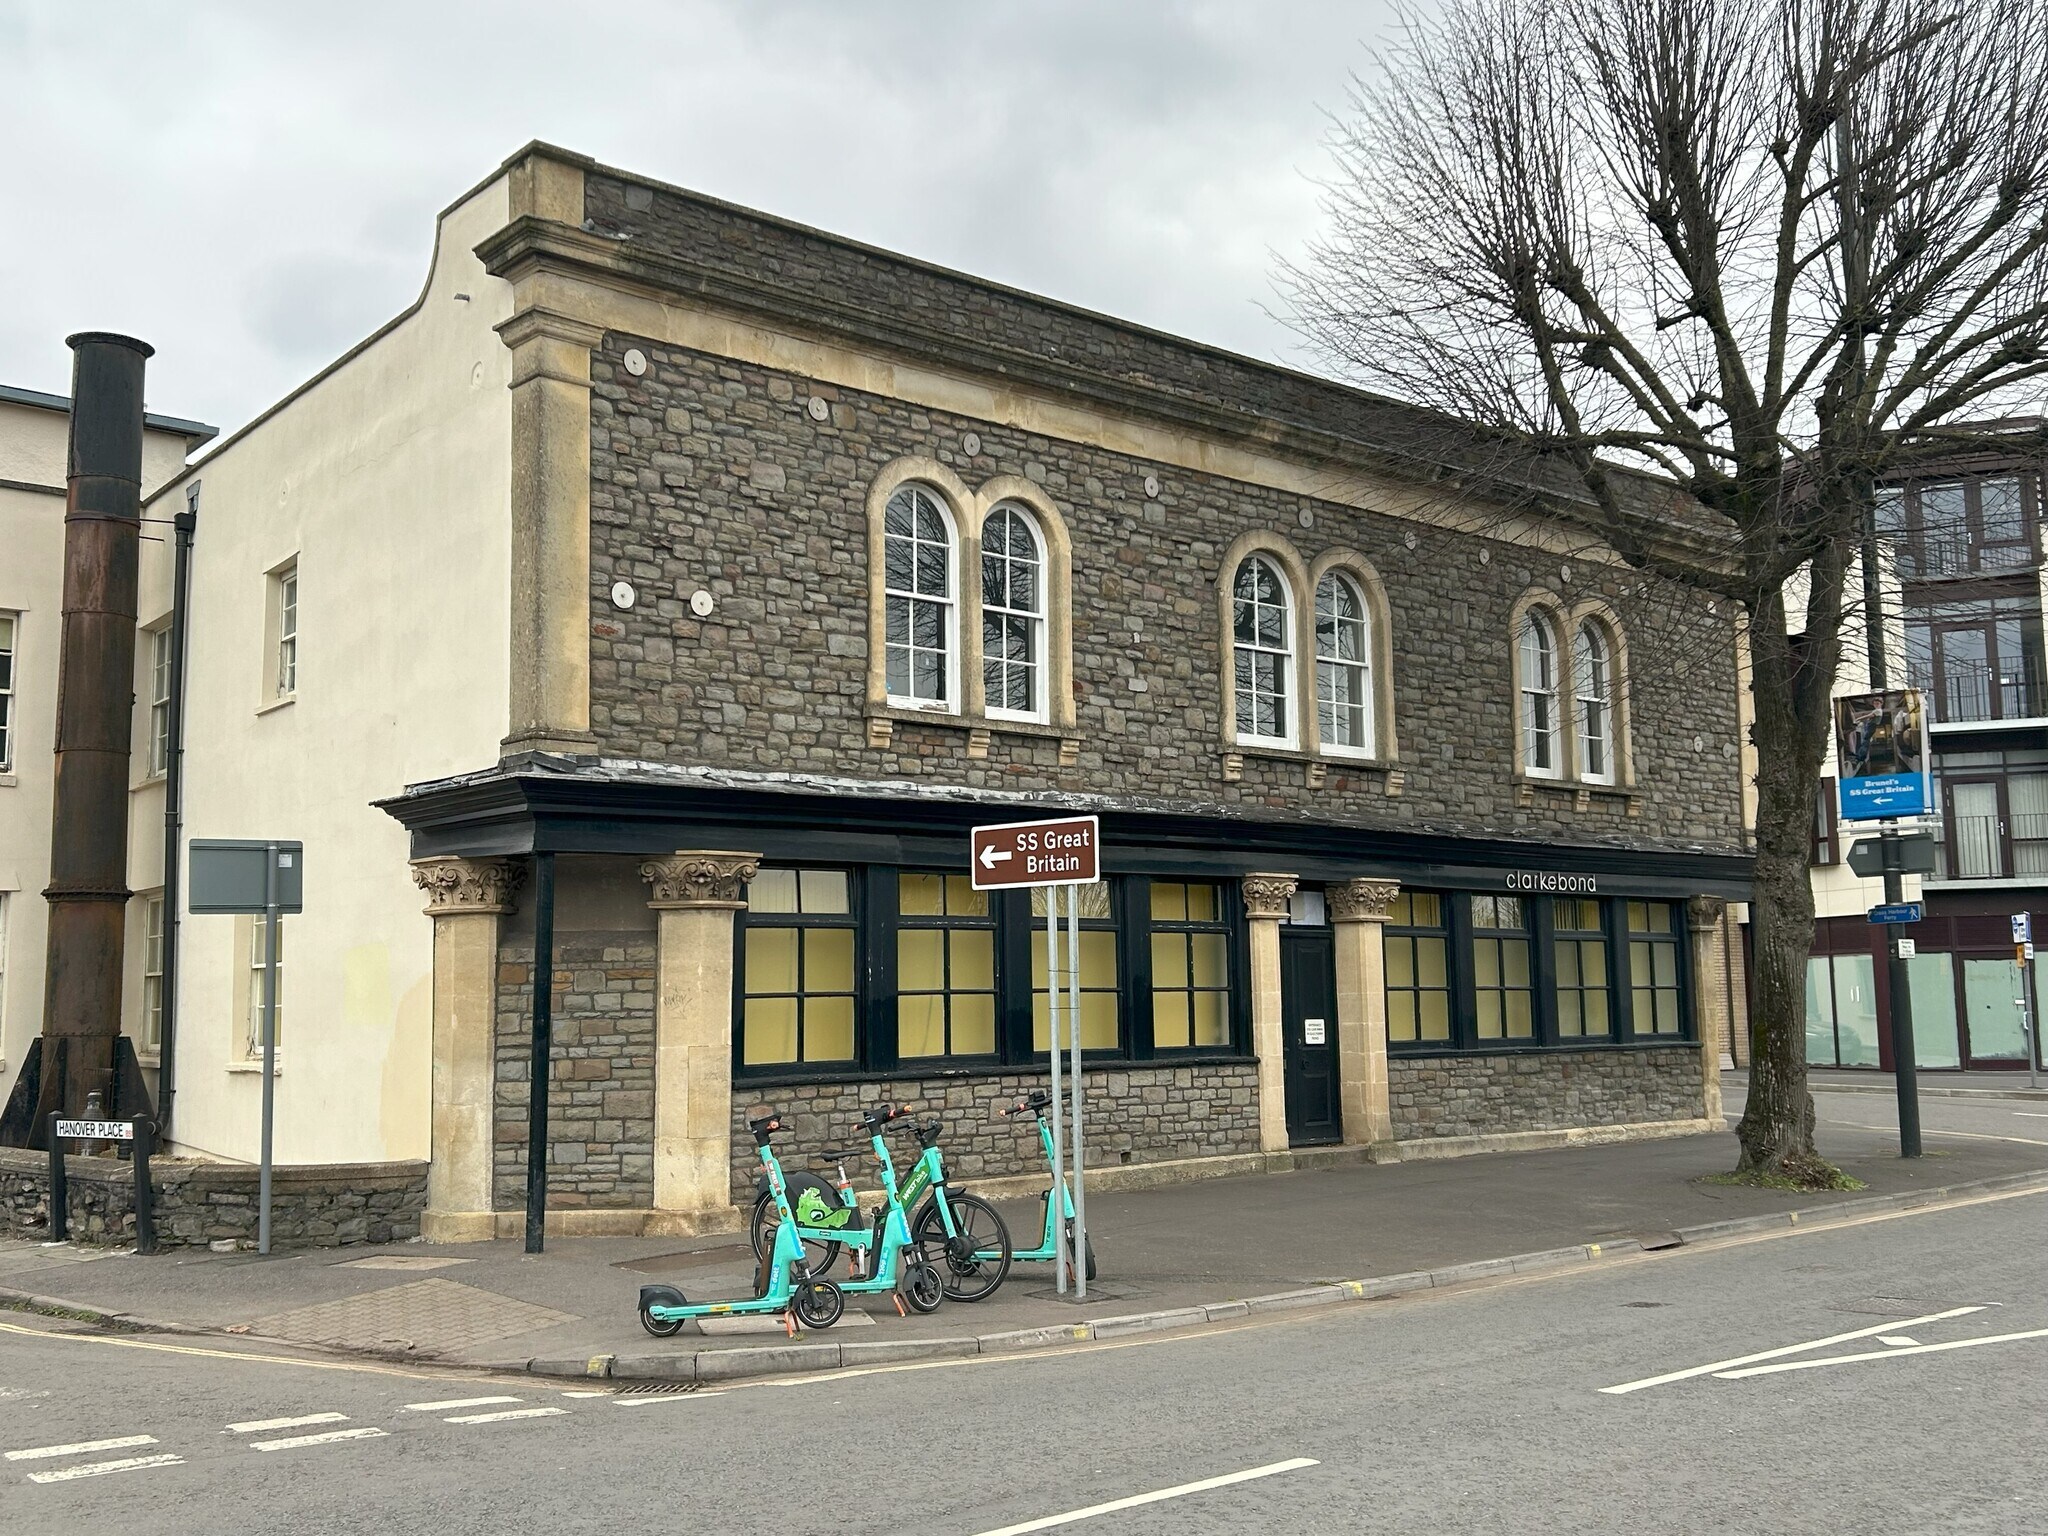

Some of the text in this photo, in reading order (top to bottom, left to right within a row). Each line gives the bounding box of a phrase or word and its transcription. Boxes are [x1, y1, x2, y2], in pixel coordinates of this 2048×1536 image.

[1865, 779, 1899, 787] Brunel's
[1885, 785, 1914, 793] Britain
[1016, 829, 1089, 851] SS Great
[1026, 853, 1079, 873] Britain
[1506, 870, 1597, 892] clarkebond
[59, 1121, 96, 1136] HANOVER
[99, 1123, 123, 1137] PLACE
